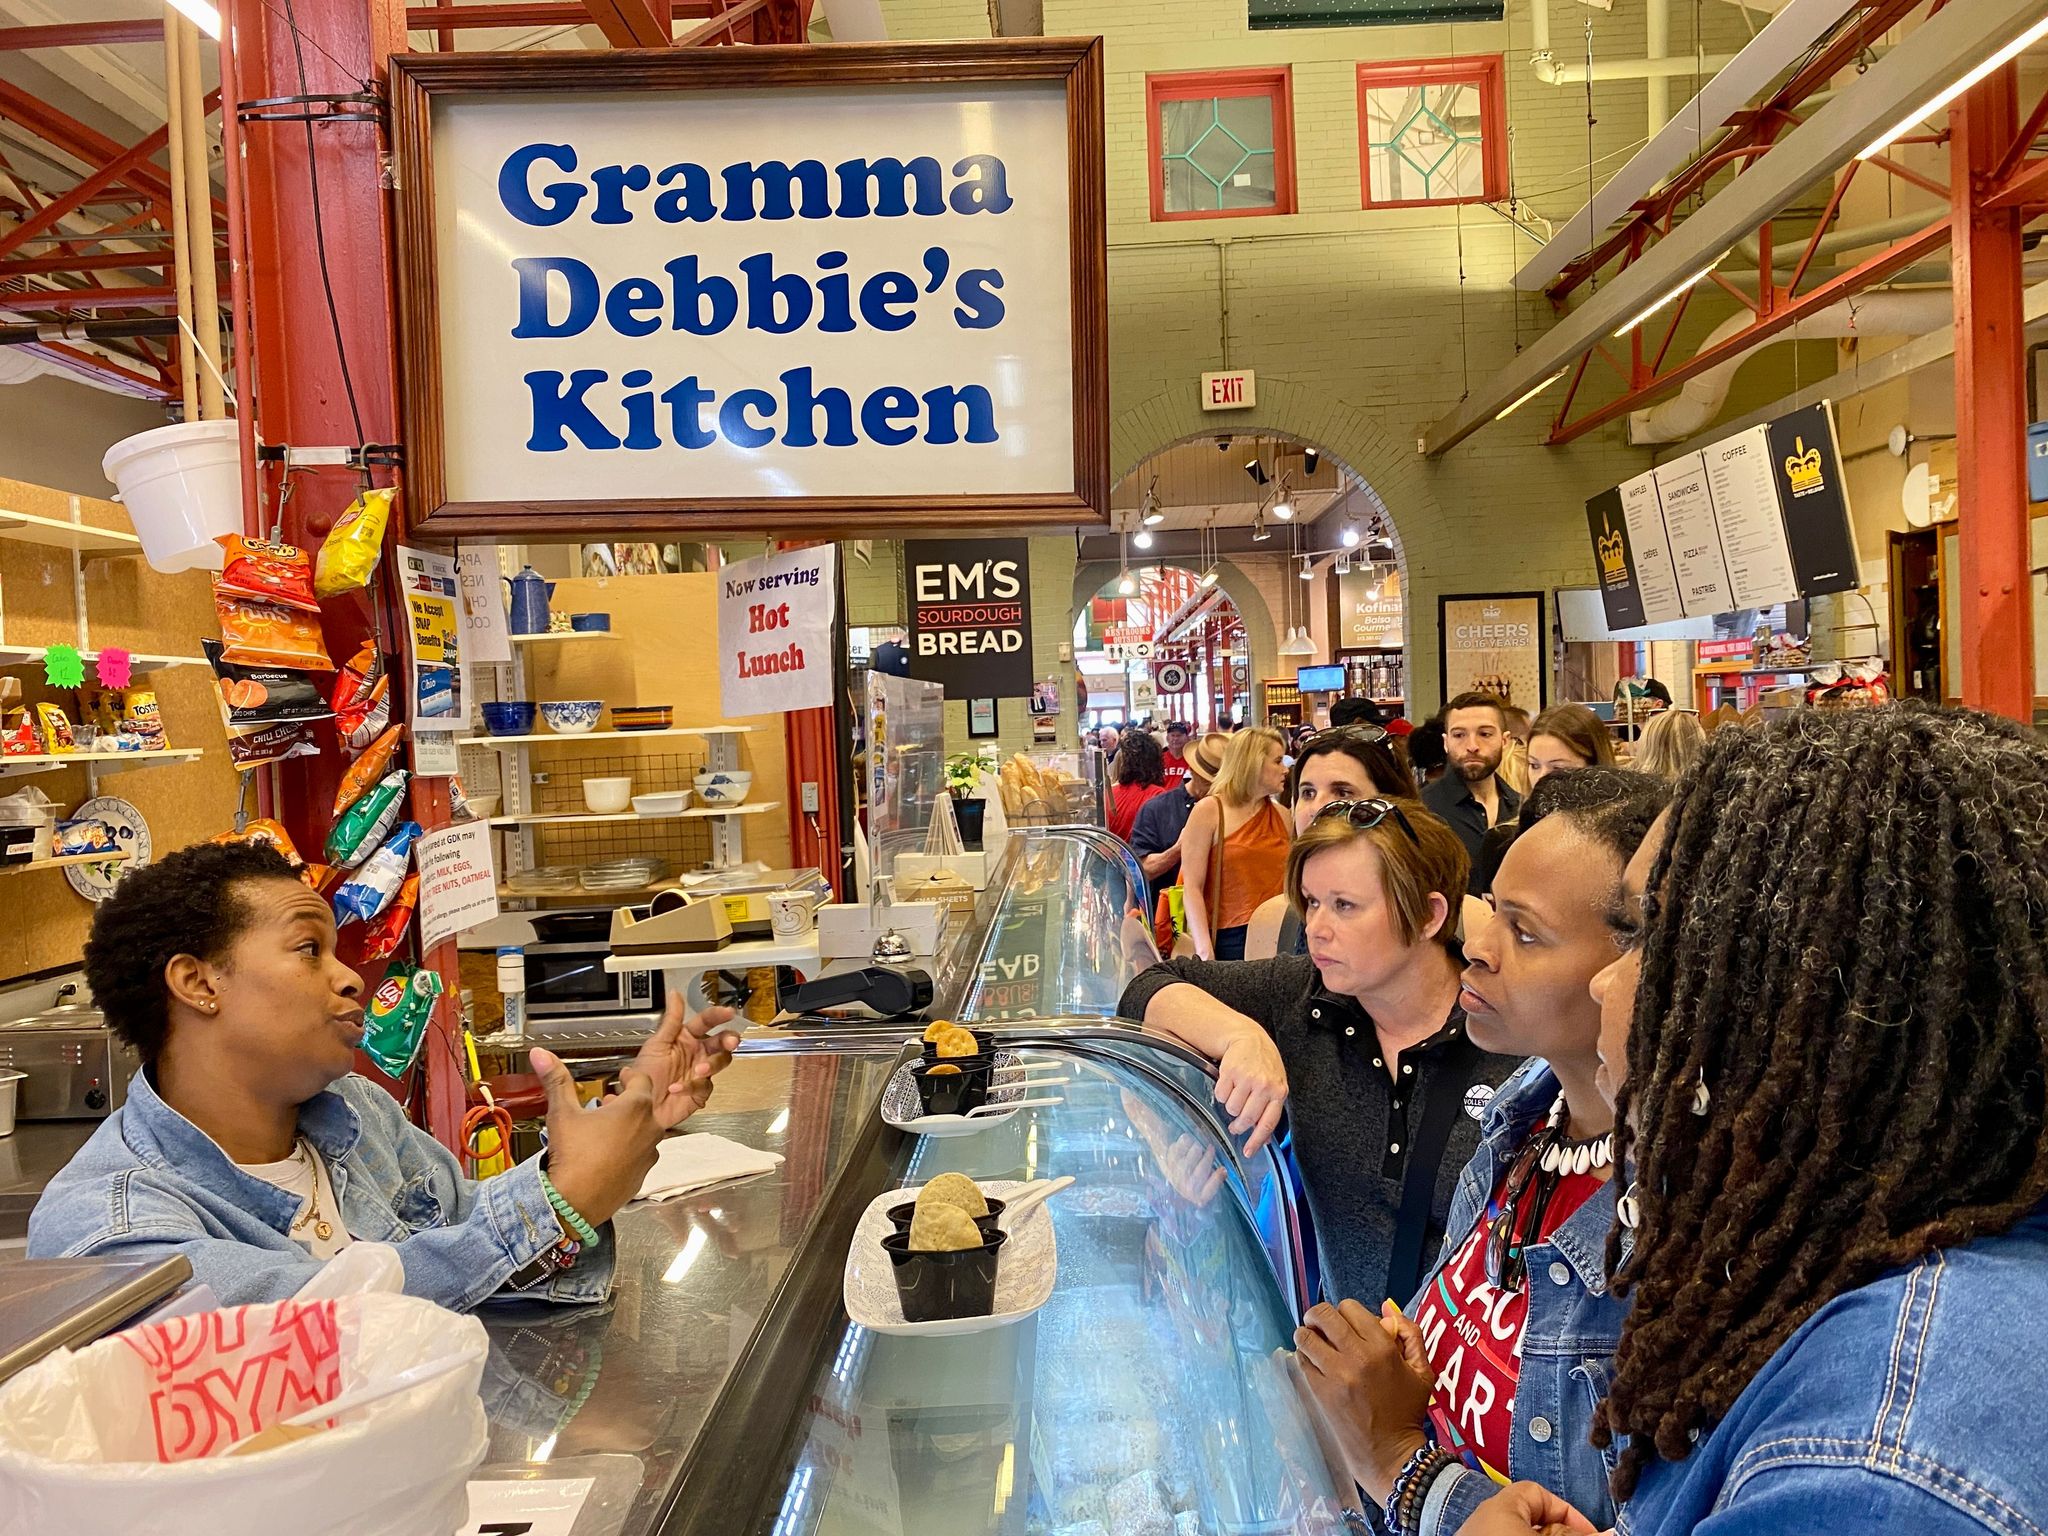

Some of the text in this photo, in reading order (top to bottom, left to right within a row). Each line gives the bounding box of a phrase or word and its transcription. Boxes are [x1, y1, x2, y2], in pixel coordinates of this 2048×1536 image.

[498, 143, 1013, 226] Gramma
[510, 246, 1006, 339] Debbie's
[1212, 377, 1244, 404] EXIT
[523, 366, 999, 452] Kitchen
[1721, 445, 1748, 462] COFFEE
[1629, 485, 1647, 498] WAFFLES
[1668, 483, 1700, 500] SANDWICHES
[1683, 549, 1699, 559] PIZZA
[726, 567, 820, 599] Now serving
[916, 559, 1020, 601] EM'S
[1691, 583, 1717, 596] PASTRIES
[412, 601, 445, 619] We Accept
[748, 602, 790, 634] Hot
[918, 607, 1022, 624] SOURDOUGH
[415, 617, 431, 630] SNAP
[1104, 626, 1151, 637] RESTROOMS
[1456, 623, 1529, 638] CHEERS
[417, 633, 441, 648] Benefits
[918, 630, 1023, 656] BREAD
[1113, 634, 1143, 644] OUTSIDE
[1457, 638, 1529, 648] TO 16 YEARS!
[443, 649, 457, 659] SNAP
[737, 642, 805, 679] Lunch
[421, 678, 436, 691] Ohio
[253, 732, 274, 744] CHILI
[447, 833, 461, 844] GDK
[462, 831, 476, 841] may
[434, 850, 461, 862] following
[436, 860, 473, 878] MILK, EGGS,
[442, 879, 461, 892] NUTS,
[462, 869, 491, 886] OATMEAL
[938, 895, 969, 903] SHEETS
[1464, 1098, 1487, 1106] VOLLEY
[1450, 1231, 1529, 1358] LAC
[1453, 1313, 1481, 1347] AND
[1415, 1285, 1515, 1448] MAR
